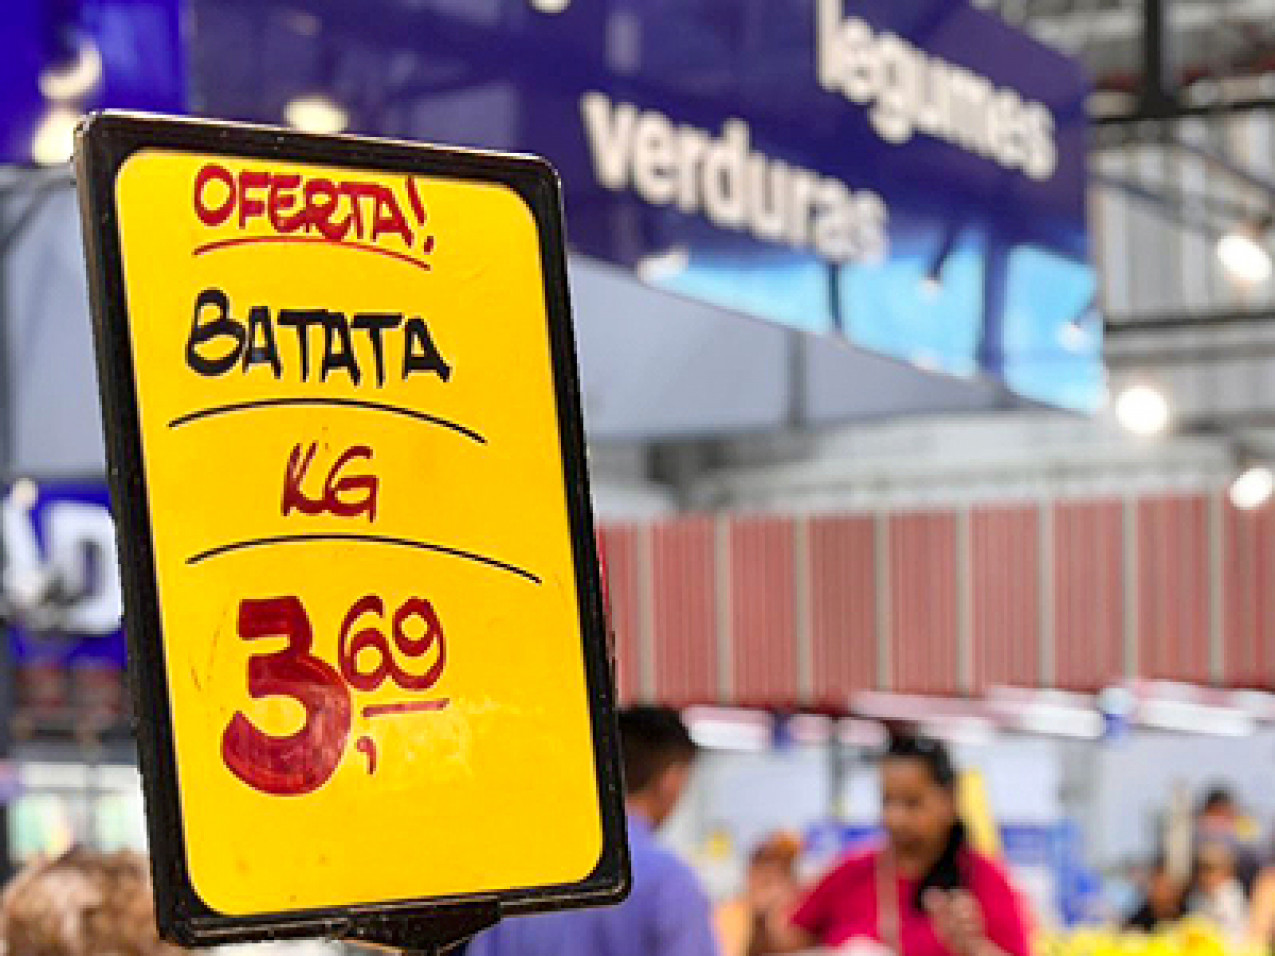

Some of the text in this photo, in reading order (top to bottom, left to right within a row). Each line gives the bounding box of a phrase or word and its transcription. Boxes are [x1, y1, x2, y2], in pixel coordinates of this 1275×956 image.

[818, 0, 1057, 180] legumes
[193, 164, 435, 254] OFERTA!
[580, 92, 889, 266] verduras
[184, 289, 451, 388] BATATA
[281, 443, 380, 523] KG
